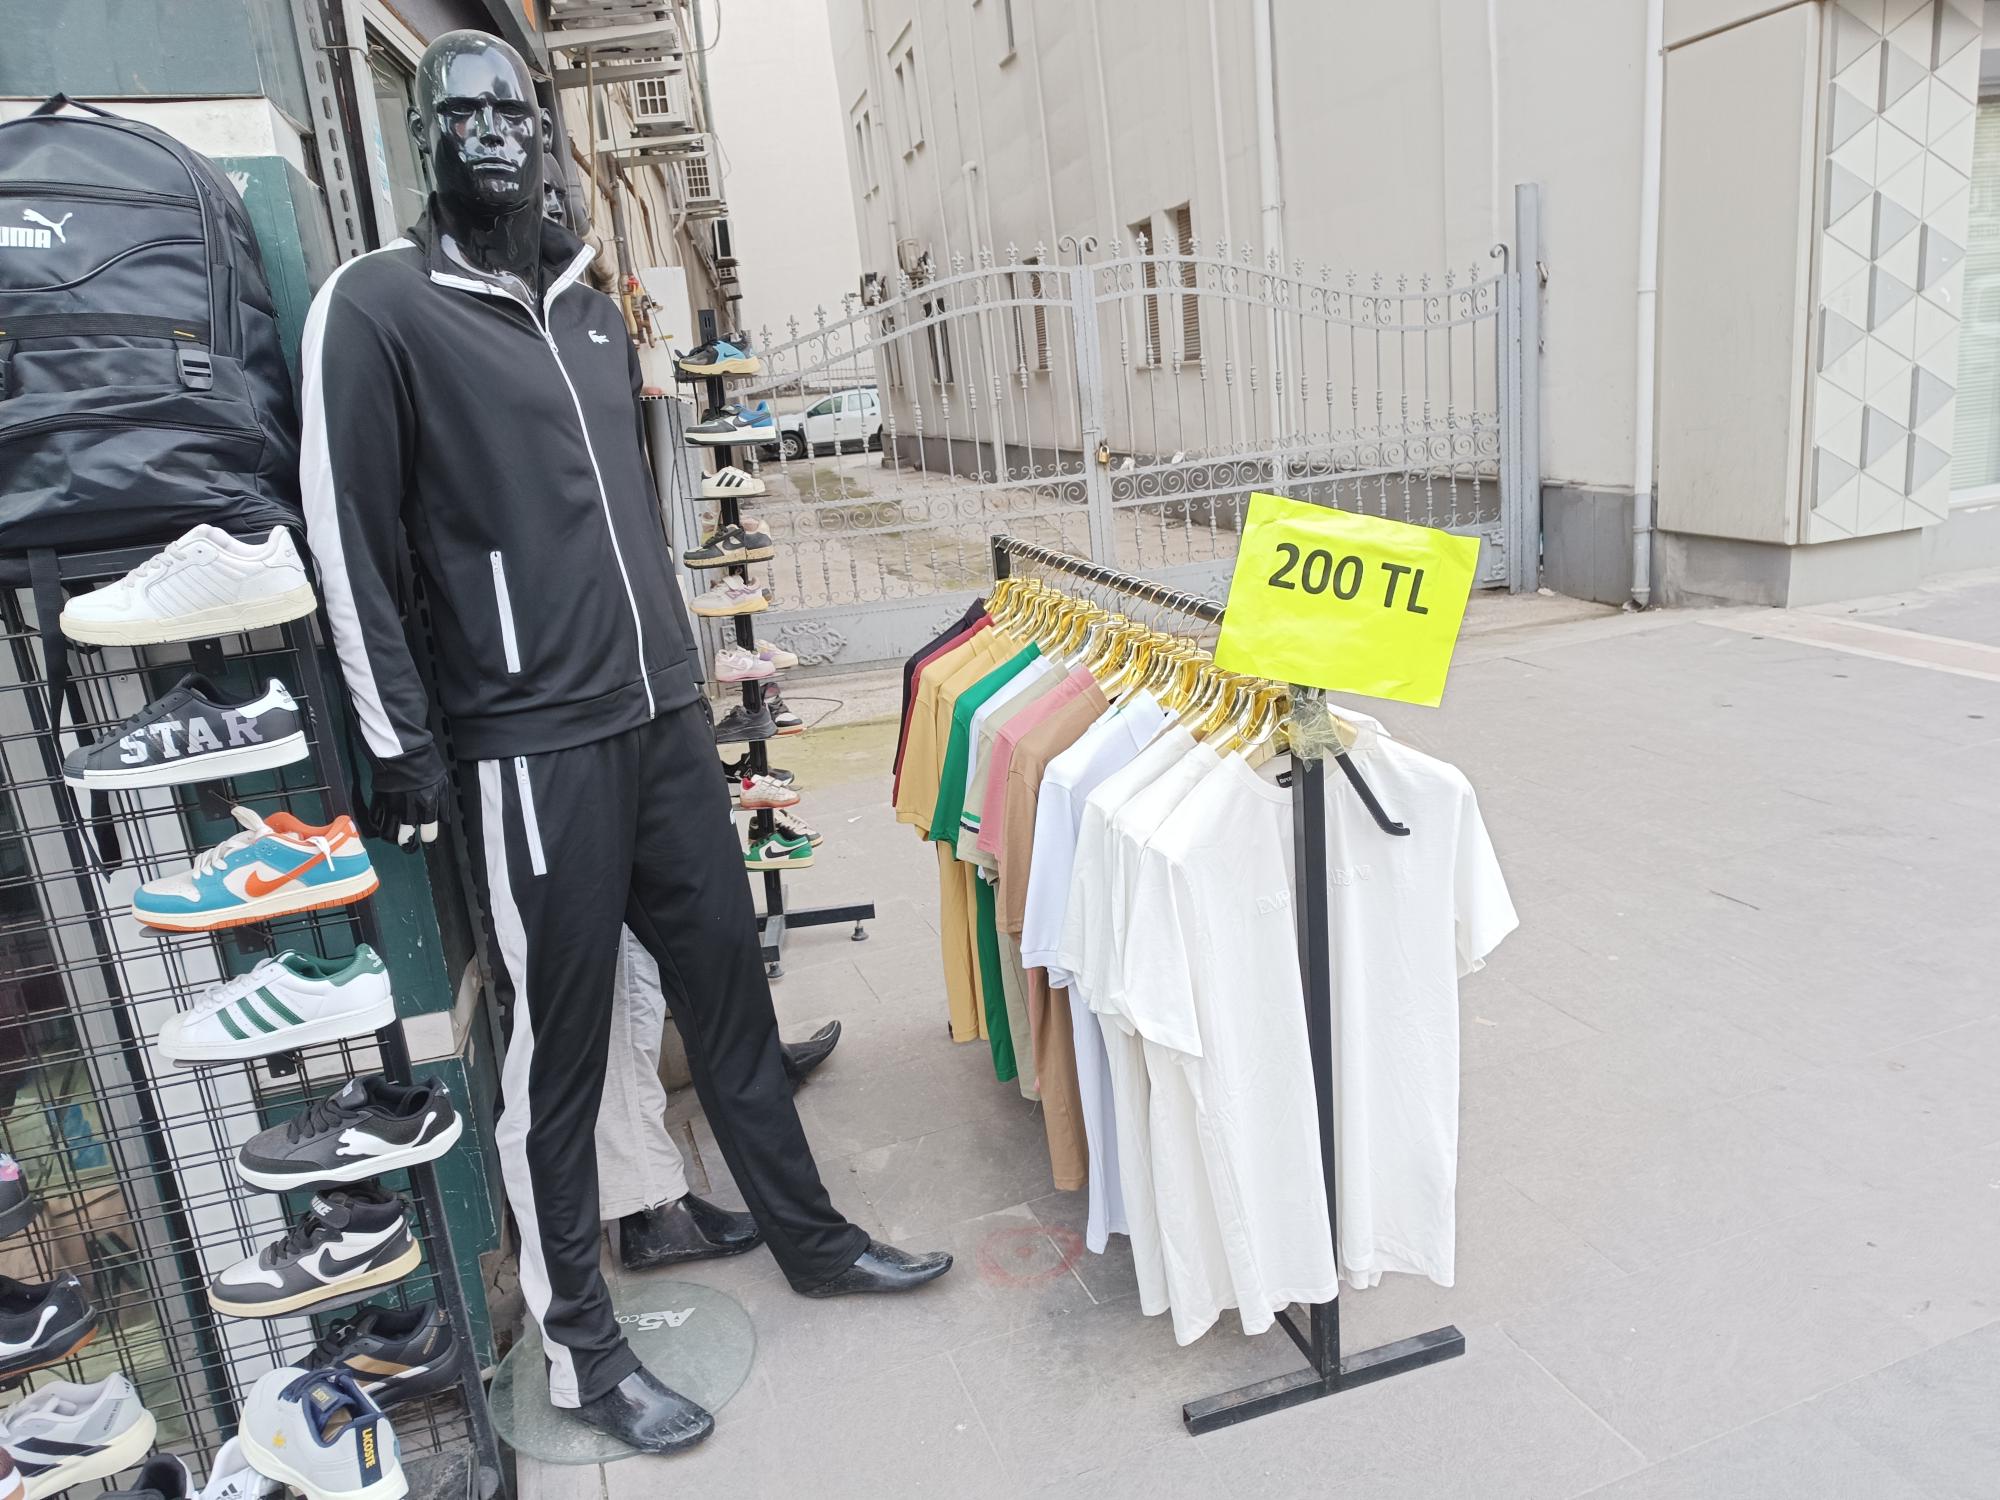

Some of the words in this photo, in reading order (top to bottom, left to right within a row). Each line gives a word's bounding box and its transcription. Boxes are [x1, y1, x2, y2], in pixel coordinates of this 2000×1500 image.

[0, 226, 51, 249] UMA
[1268, 542, 1364, 601] 200
[1381, 562, 1429, 615] TL
[119, 709, 263, 765] STAR
[361, 1427, 377, 1470] LACOSTE
